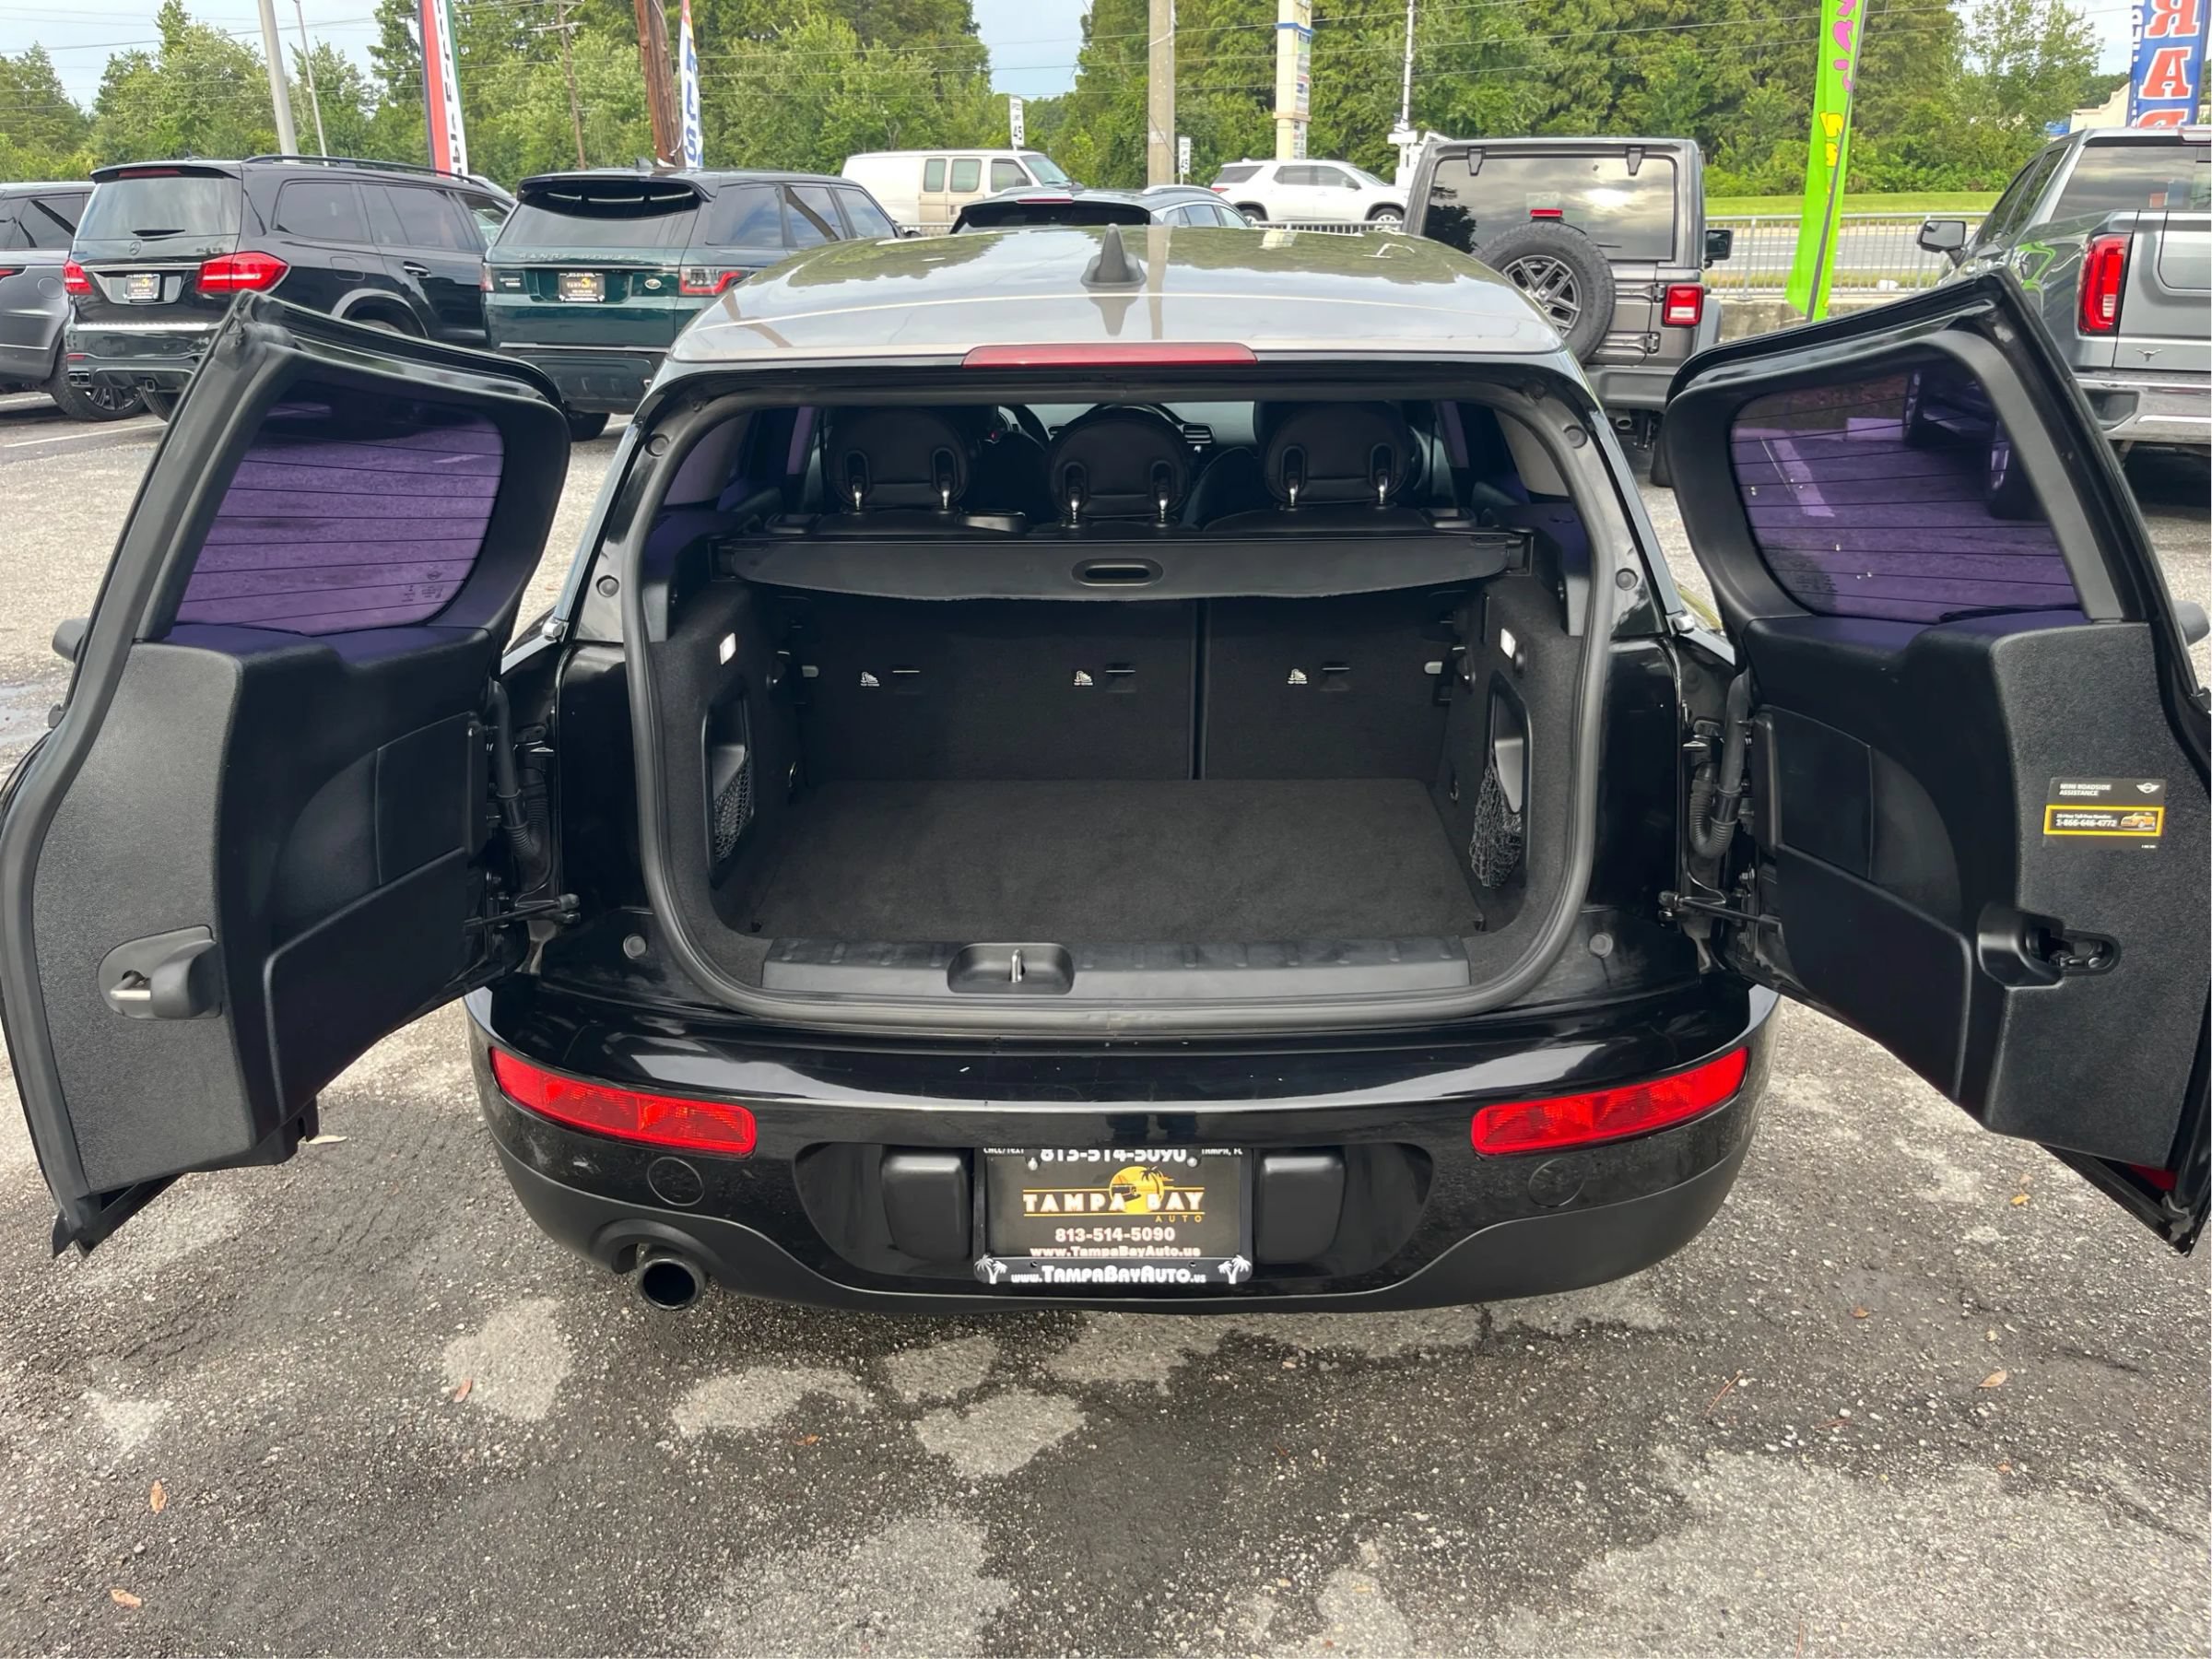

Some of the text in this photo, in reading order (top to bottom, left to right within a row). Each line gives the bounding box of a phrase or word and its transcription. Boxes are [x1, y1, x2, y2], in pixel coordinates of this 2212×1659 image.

[1013, 125, 1023, 141] 45
[1023, 1192, 1205, 1212] TAMPA BAY
[1155, 1215, 1203, 1223] AUTO
[1054, 1227, 1176, 1242] 813-514-5090
[1030, 1245, 1202, 1257] www.TampaBayAuto.us
